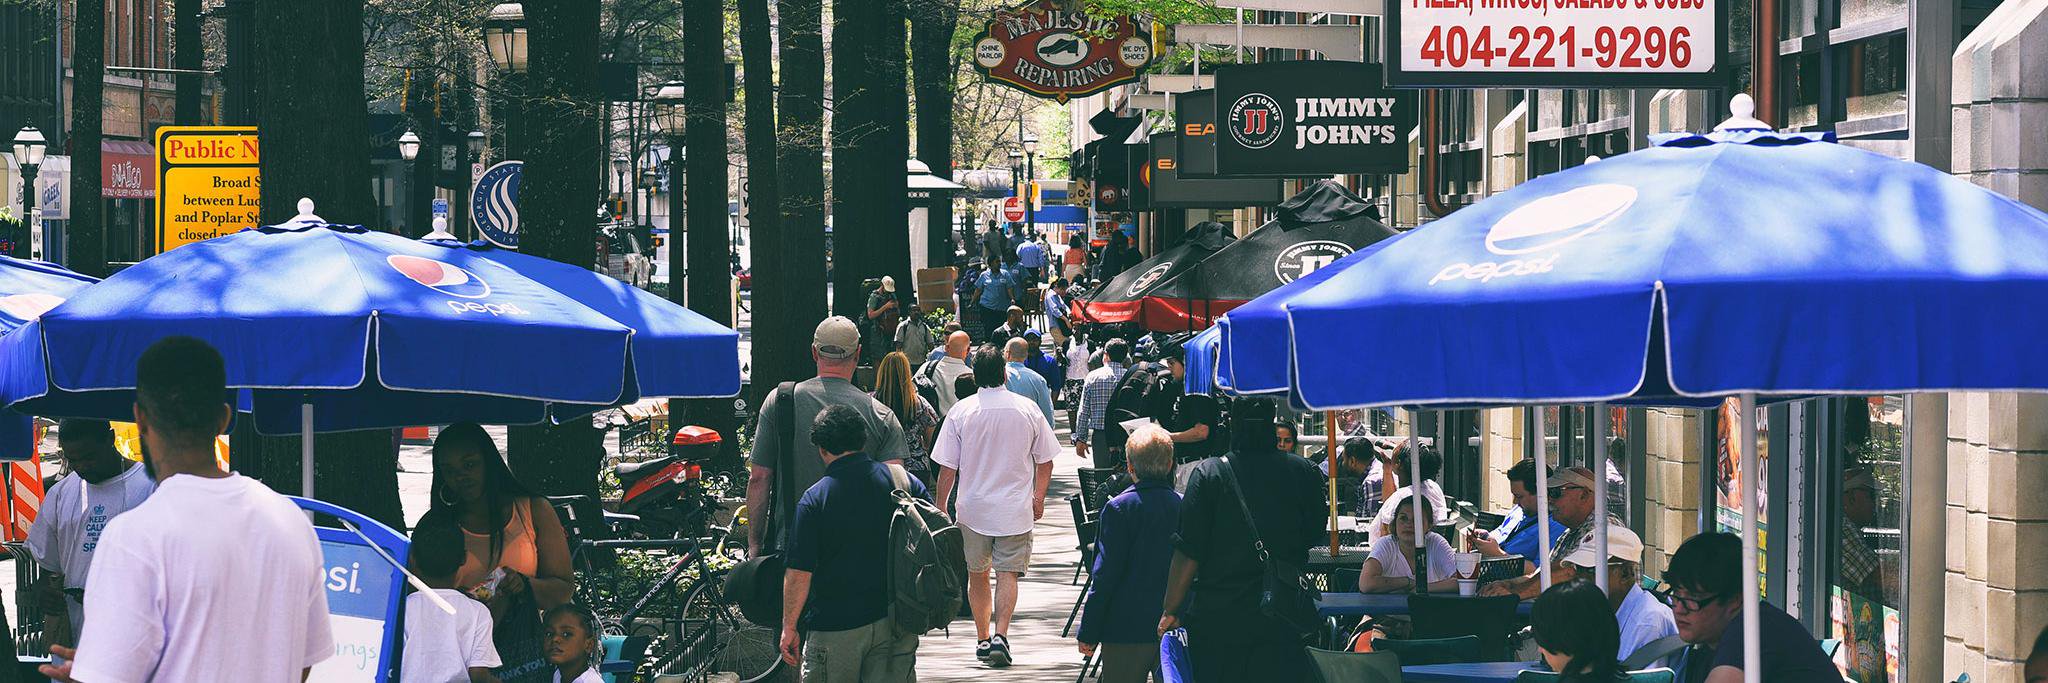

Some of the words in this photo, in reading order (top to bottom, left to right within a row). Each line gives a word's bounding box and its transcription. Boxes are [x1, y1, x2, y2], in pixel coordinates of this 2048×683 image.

[1005, 11, 1119, 40] MAJESTIC
[1420, 26, 1691, 68] 404-221-9296
[977, 52, 1003, 60] PARLOR
[1124, 53, 1145, 61] SHOES
[1014, 57, 1114, 88] REPAIRING
[1232, 97, 1254, 121] JIMMY
[1295, 98, 1396, 123] JIMMY
[1295, 125, 1396, 150] JOHN'S
[169, 139, 236, 158] Public
[212, 175, 251, 188] Broad
[183, 194, 234, 206] between
[476, 184, 492, 232] GEORGIA
[174, 211, 198, 223] and
[201, 210, 243, 226] Poplar
[178, 228, 217, 240] closed
[1286, 245, 1317, 259] JIMMY
[1428, 253, 1561, 286] pepsi
[447, 301, 531, 317] pepsi
[89, 515, 107, 523] KEEP
